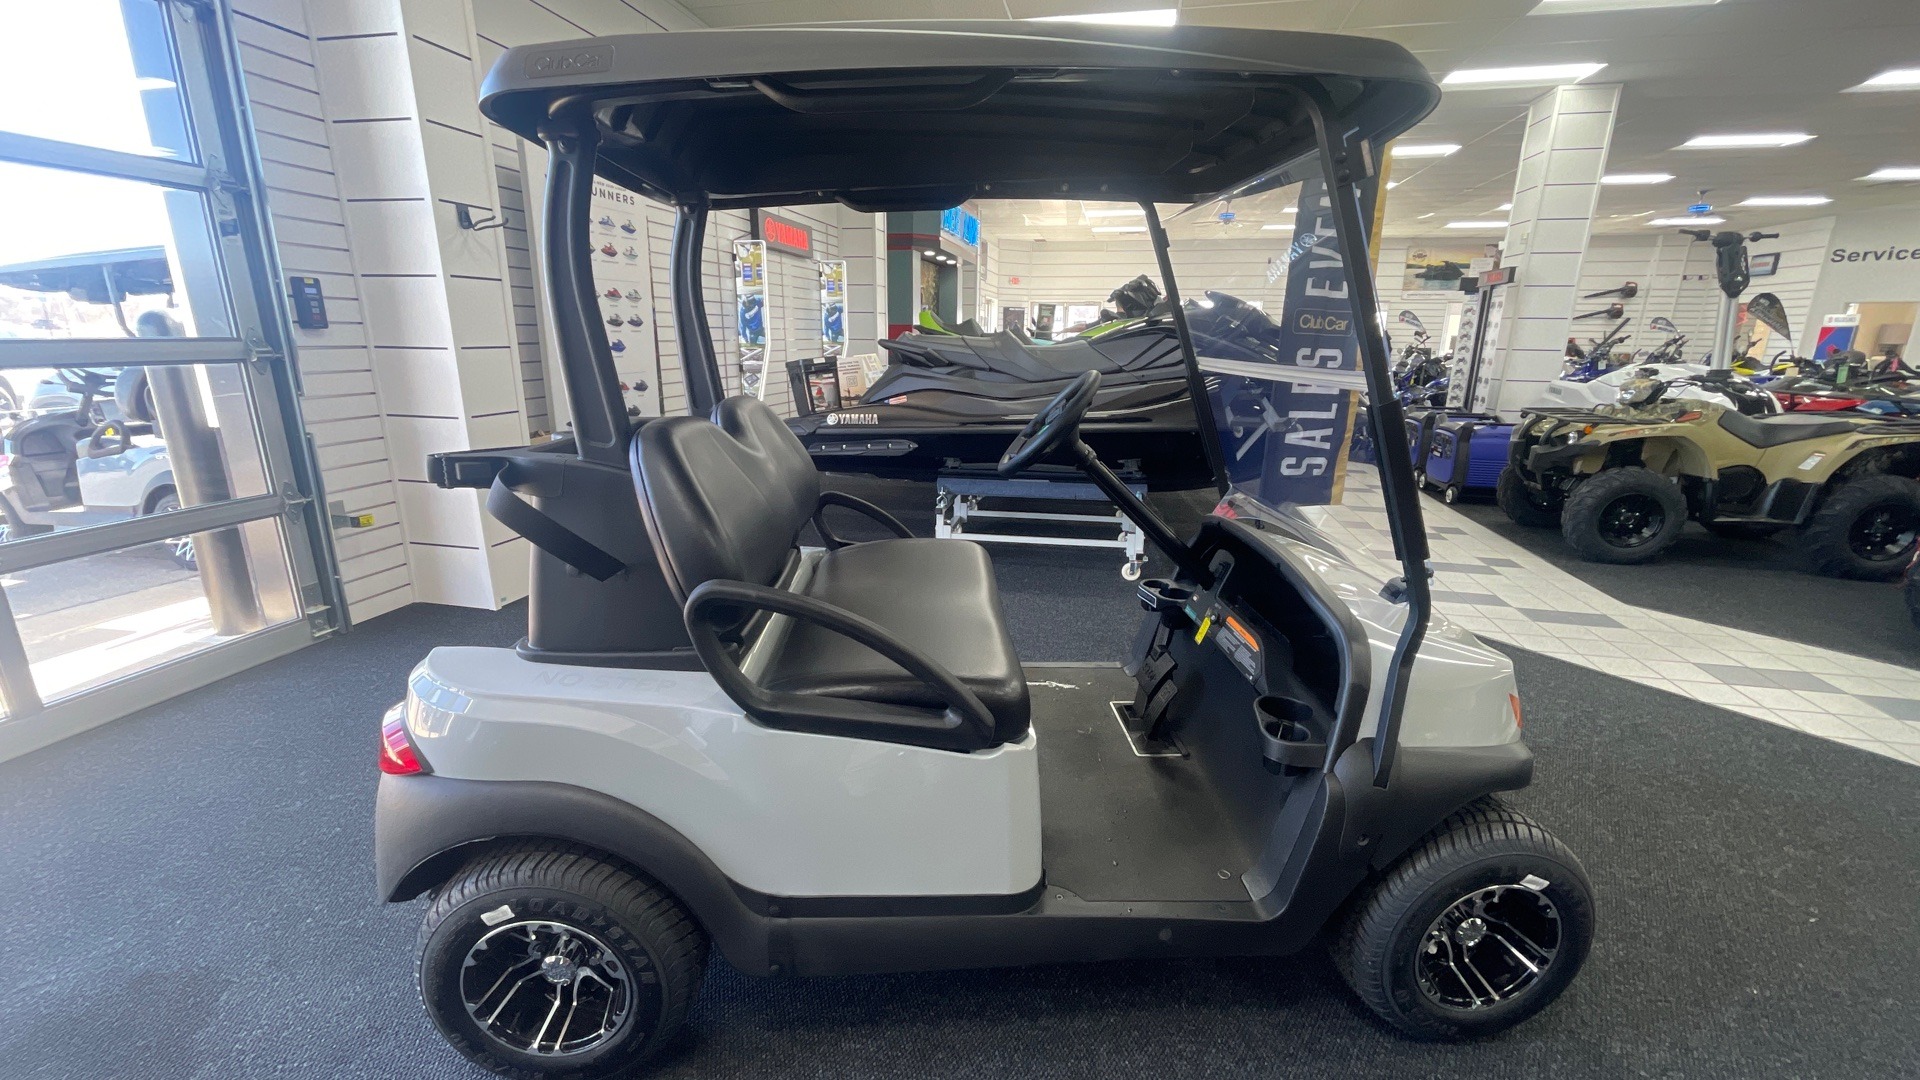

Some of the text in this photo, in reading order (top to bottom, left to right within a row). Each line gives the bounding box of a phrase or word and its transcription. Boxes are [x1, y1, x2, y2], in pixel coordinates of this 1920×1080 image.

[775, 222, 809, 251] YAMAHA
[1830, 246, 1920, 263] Service
[839, 413, 879, 425] YAMAHA
